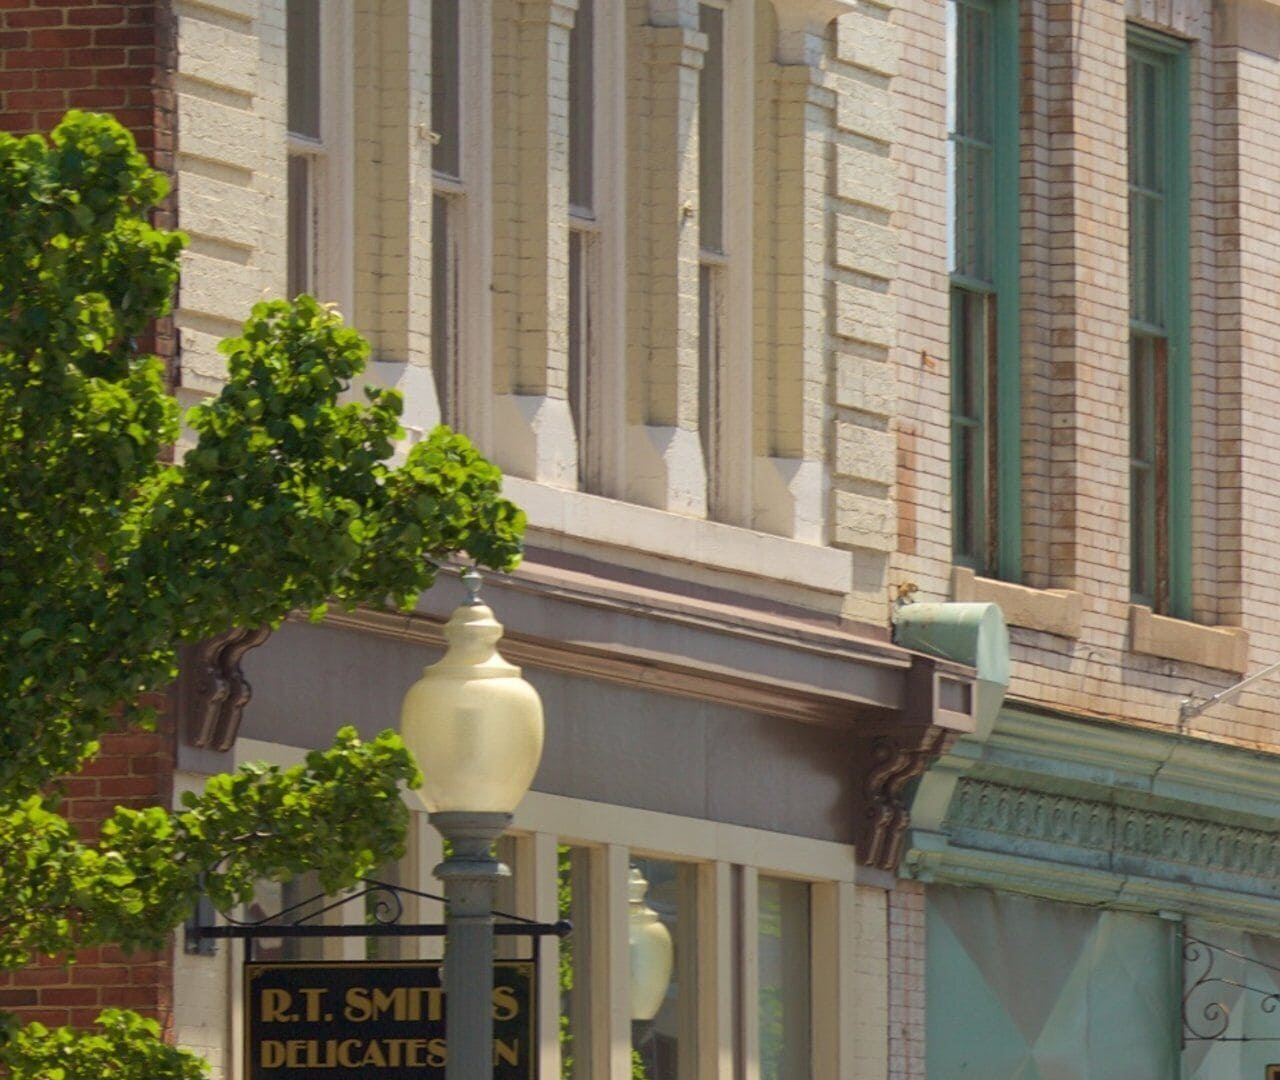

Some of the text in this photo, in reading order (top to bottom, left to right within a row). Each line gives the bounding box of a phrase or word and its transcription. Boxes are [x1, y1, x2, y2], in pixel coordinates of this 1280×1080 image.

[260, 987, 519, 1023] R.T. SMITS
[260, 1039, 519, 1069] DELICATESN
